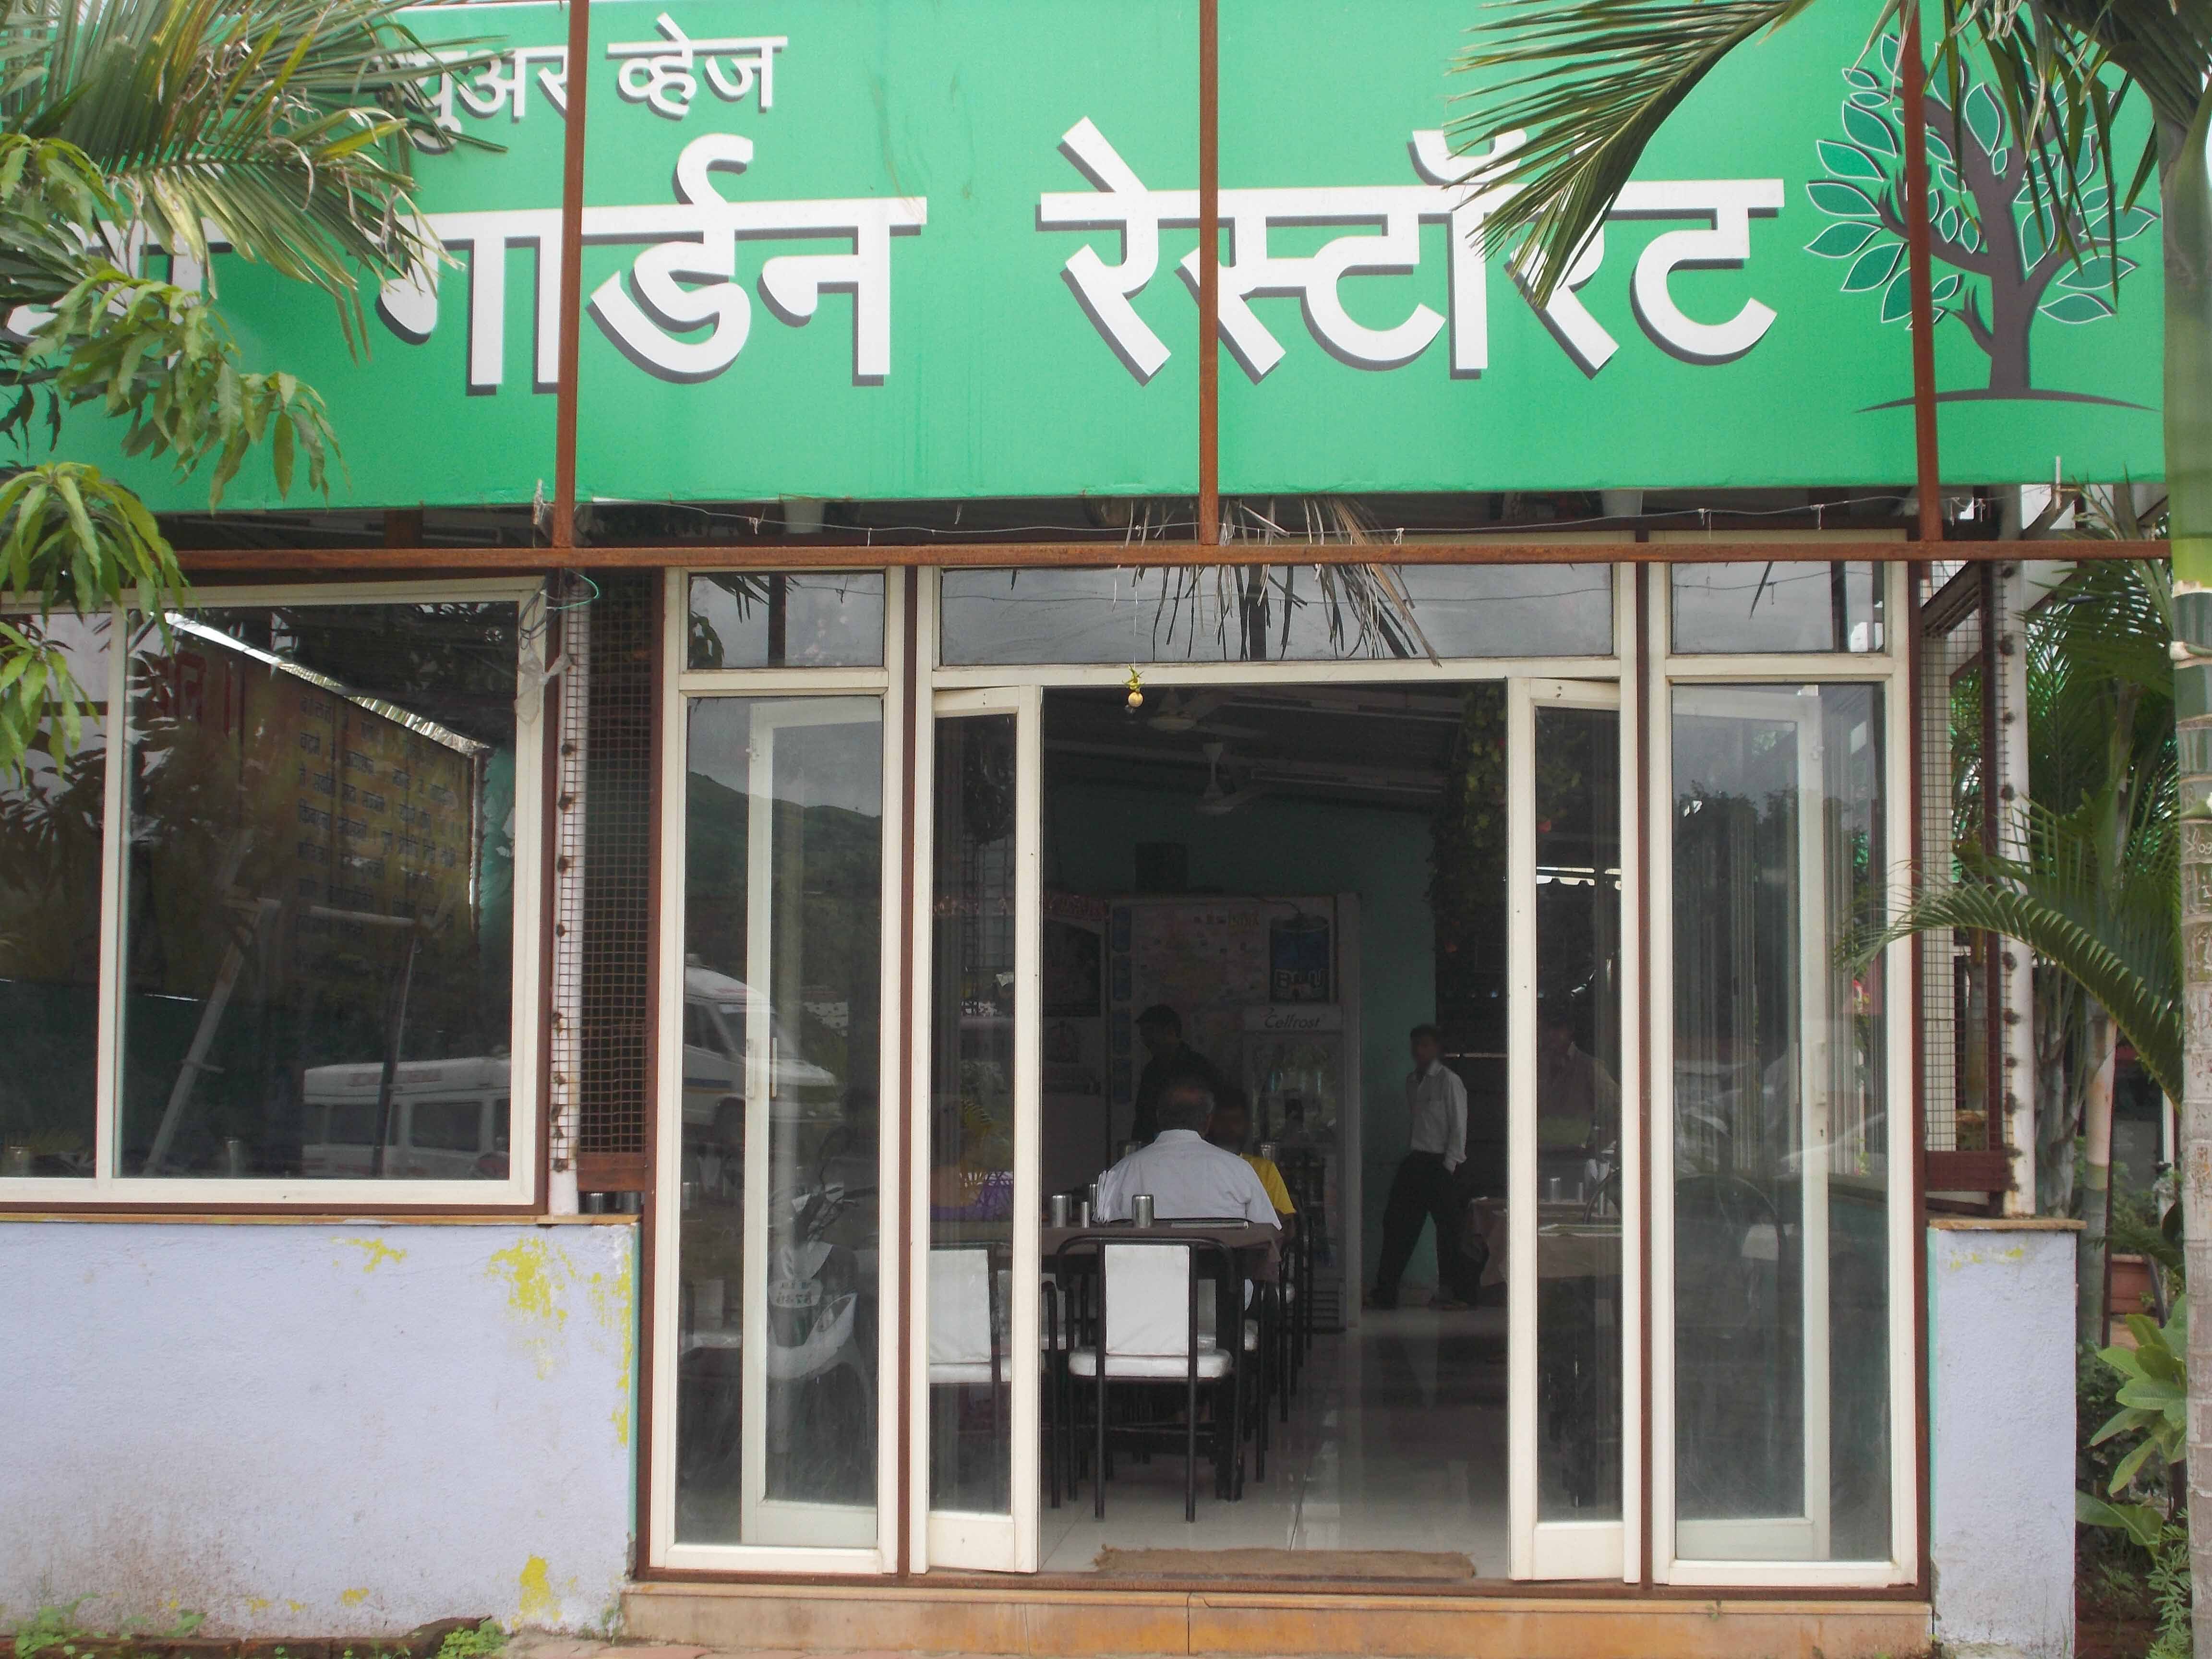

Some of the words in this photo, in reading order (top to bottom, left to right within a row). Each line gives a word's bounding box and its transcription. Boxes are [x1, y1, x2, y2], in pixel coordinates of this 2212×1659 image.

[606, 12, 788, 119] व्हेज
[359, 134, 927, 387] गार्डन
[1264, 1013, 1321, 1029] Celfrost
